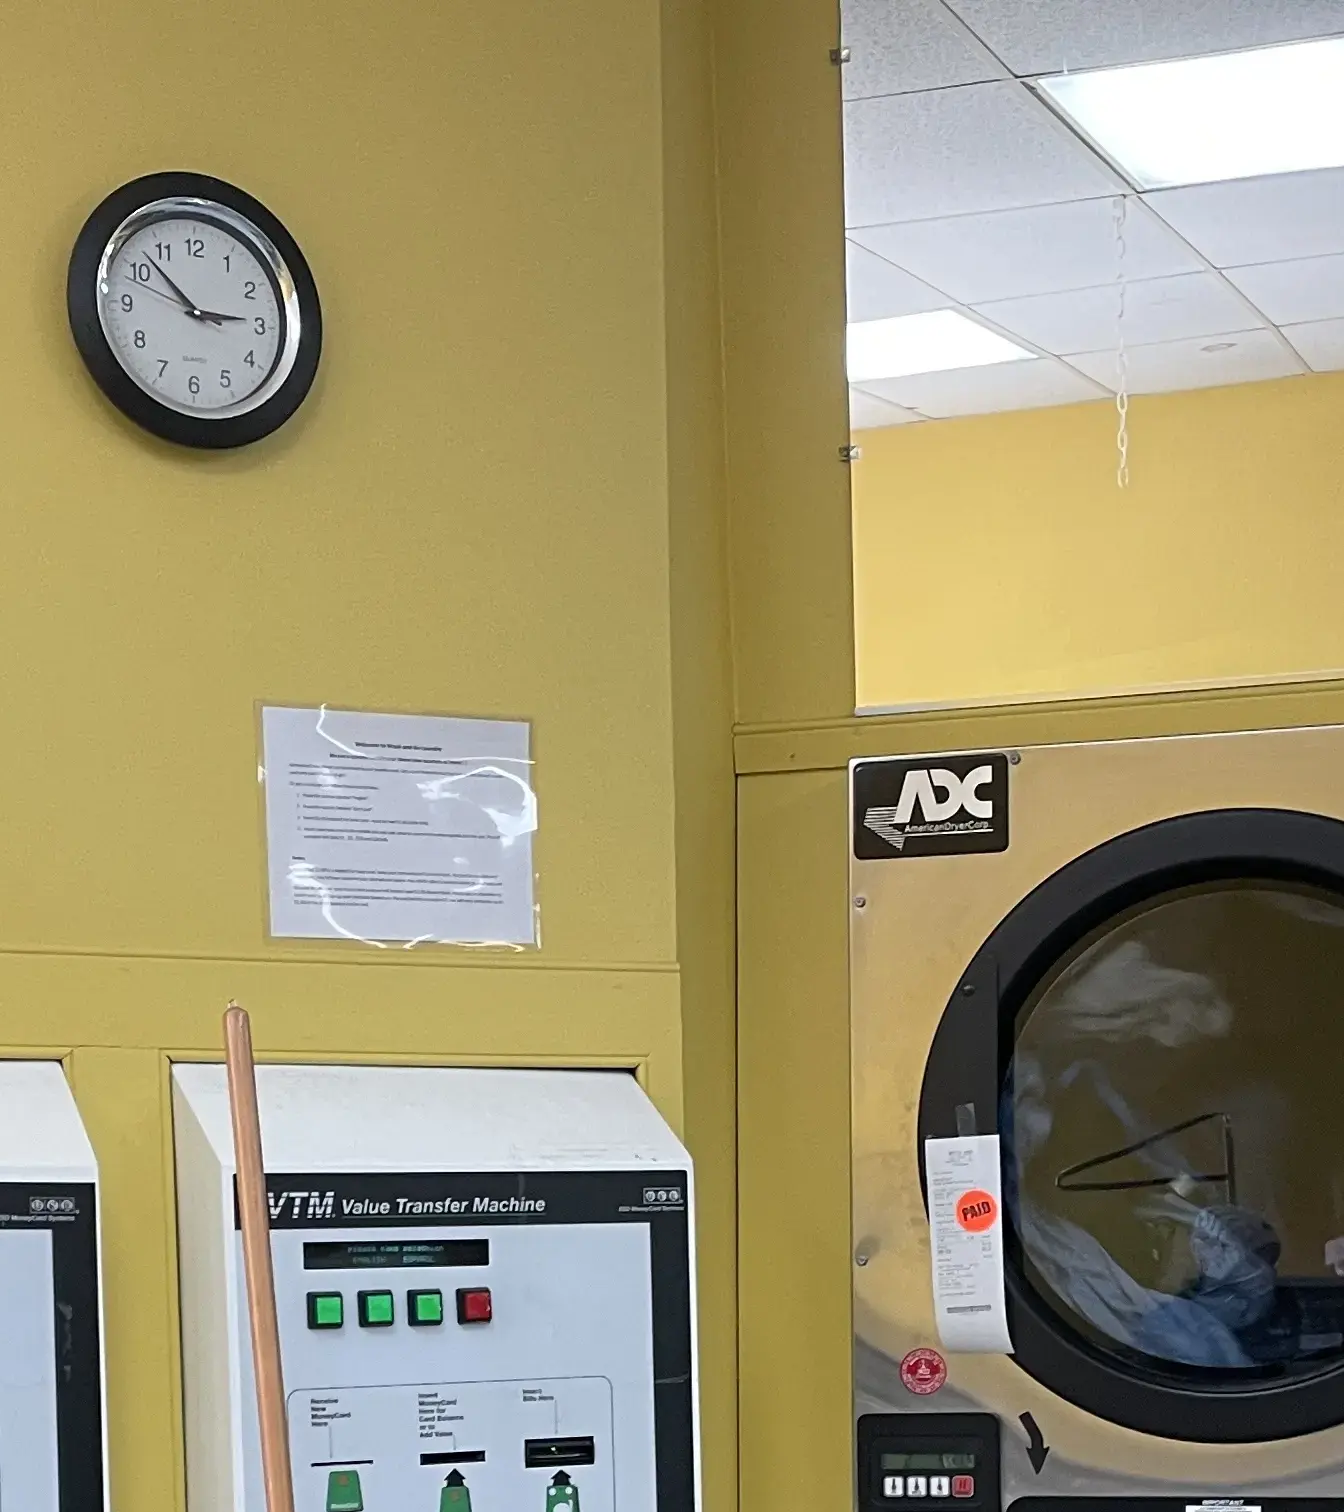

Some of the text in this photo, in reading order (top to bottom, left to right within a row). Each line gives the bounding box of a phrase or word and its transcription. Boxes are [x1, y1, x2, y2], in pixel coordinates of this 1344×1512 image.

[155, 242, 172, 262] 11
[184, 238, 205, 258] 12
[129, 263, 151, 282] 10
[222, 255, 230, 273] 1
[244, 281, 256, 300] 2
[121, 294, 133, 313] 9
[254, 317, 266, 336] 3
[133, 330, 146, 349] 8
[157, 359, 169, 378] 7
[243, 350, 255, 368] 4
[188, 375, 200, 394] 6
[220, 369, 232, 388] 5
[893, 765, 993, 823] ADC
[267, 1191, 547, 1219] VTM Value Transfer Machine
